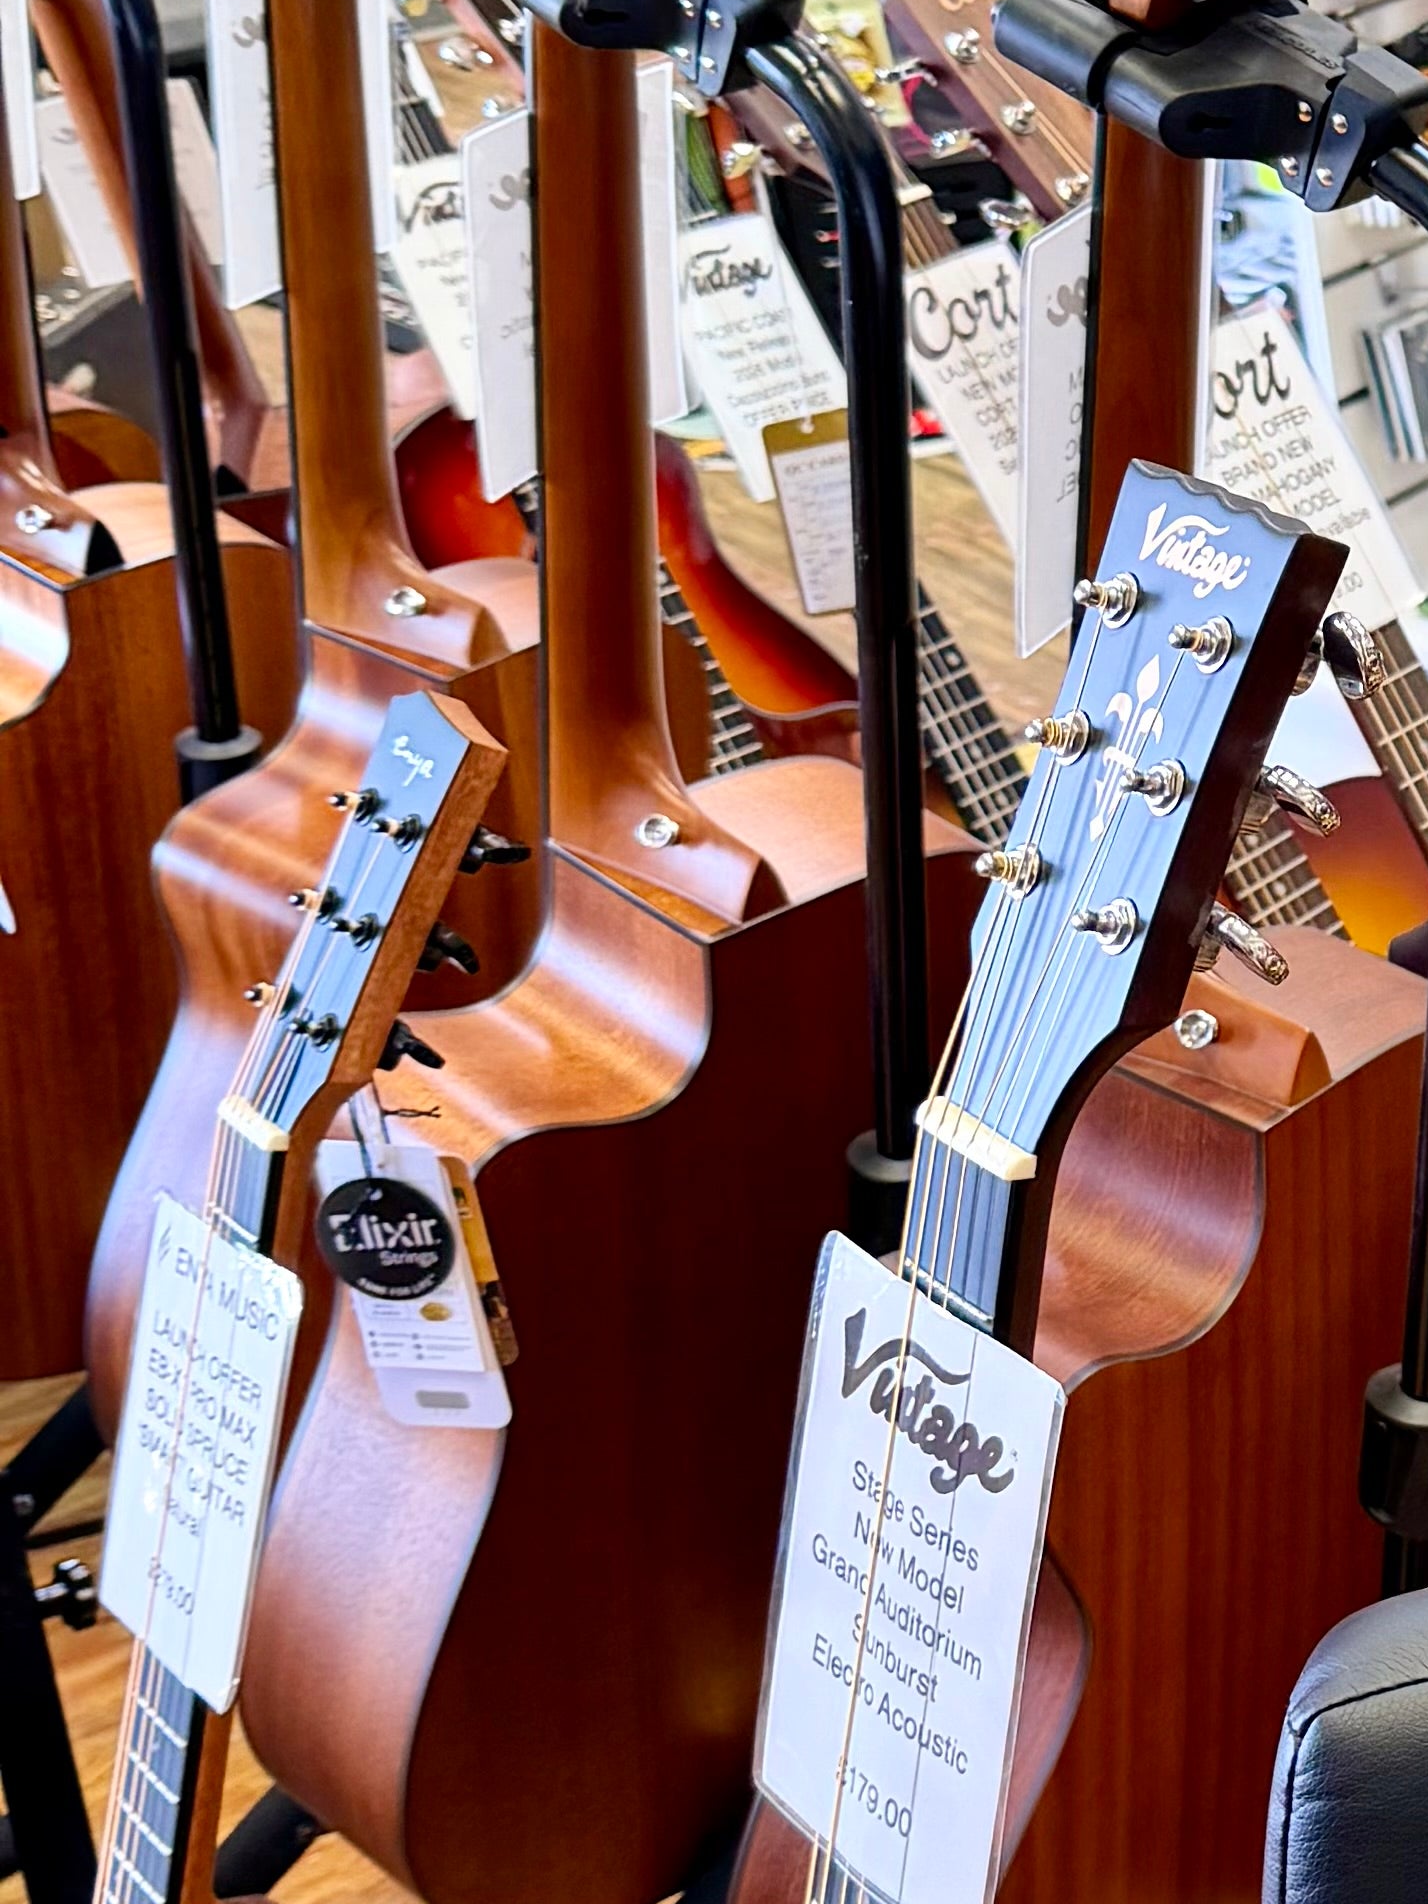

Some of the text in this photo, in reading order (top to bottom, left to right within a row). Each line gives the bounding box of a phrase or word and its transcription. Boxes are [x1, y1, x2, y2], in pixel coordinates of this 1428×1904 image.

[910, 263, 1019, 362] Cort
[1213, 331, 1291, 420] ort
[1262, 405, 1312, 438] OFFER
[1220, 435, 1314, 489] BRAND NEW
[1138, 501, 1252, 599] Vintage
[328, 1212, 438, 1253] Elixir
[217, 1279, 281, 1342] MUSIC
[841, 1306, 1013, 1495] Vintage
[852, 1459, 980, 1572] Stage Series
[853, 1511, 965, 1614] New Model
[852, 1609, 940, 1703] Sunburst
[874, 1580, 983, 1681] Auditorium
[811, 1633, 969, 1776] Electro Acoustic
